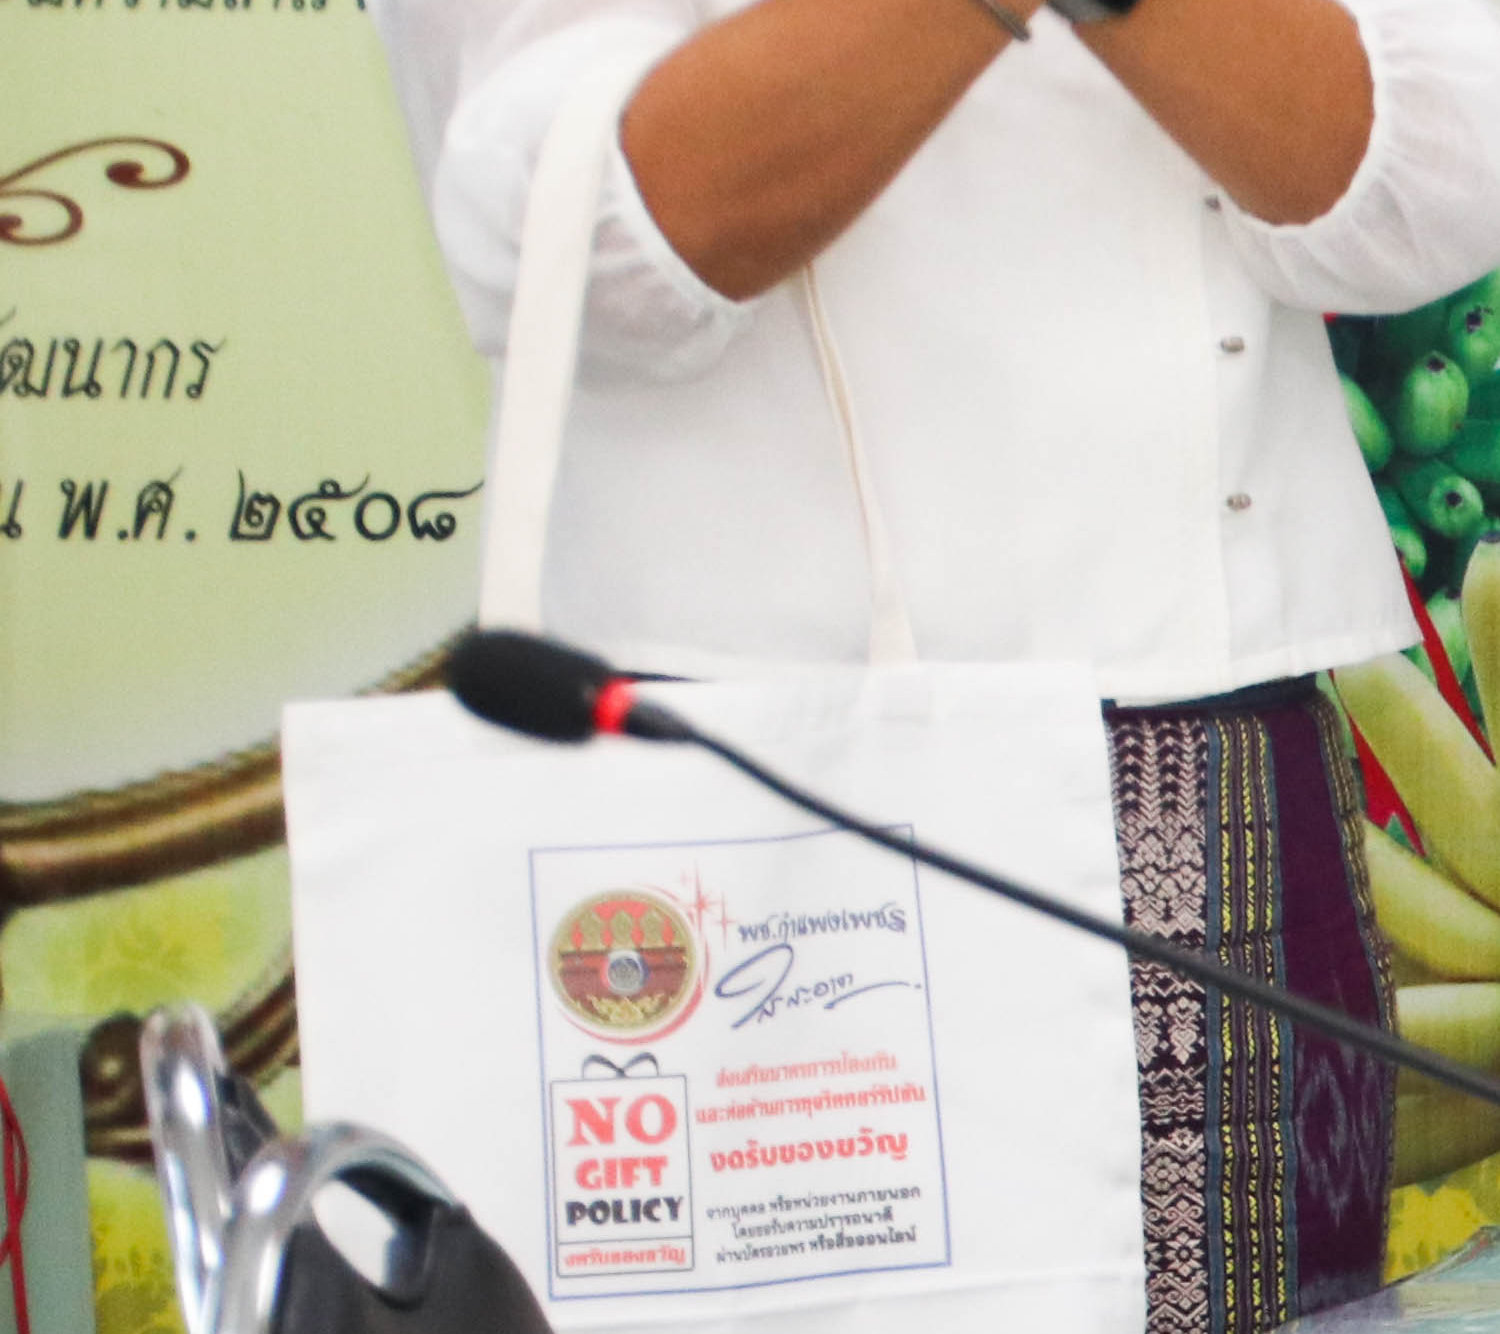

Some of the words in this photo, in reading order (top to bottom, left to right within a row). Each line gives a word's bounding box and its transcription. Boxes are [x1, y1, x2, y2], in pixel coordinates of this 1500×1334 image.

[58, 465, 197, 541] พ.ศ.
[229, 468, 485, 542] ๒๕๐๘
[564, 1093, 678, 1147] NO
[575, 1154, 669, 1191] GIFT
[565, 1195, 684, 1226] POLICY
